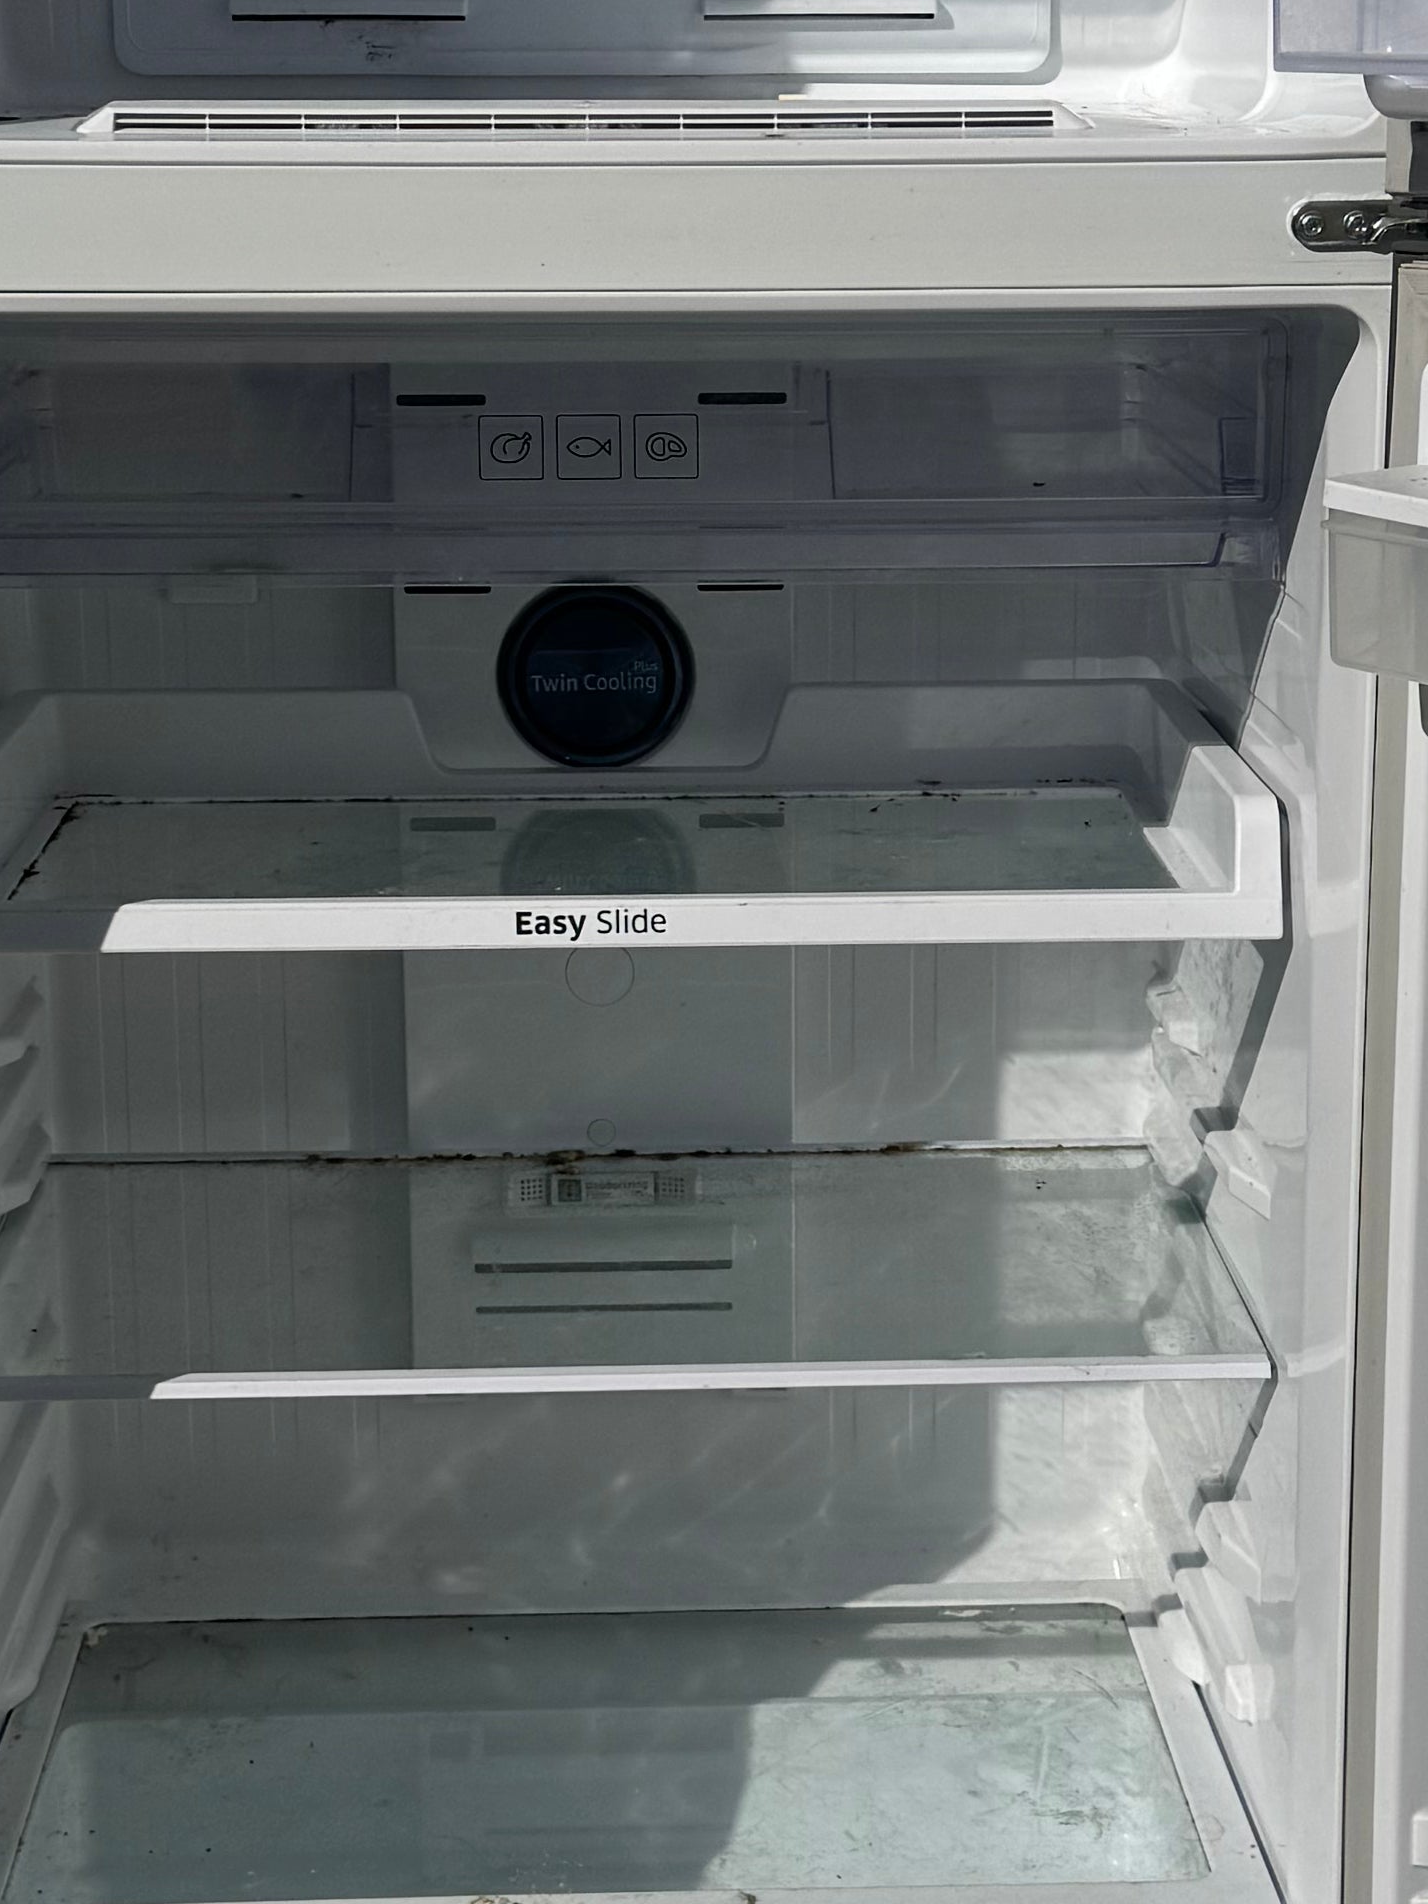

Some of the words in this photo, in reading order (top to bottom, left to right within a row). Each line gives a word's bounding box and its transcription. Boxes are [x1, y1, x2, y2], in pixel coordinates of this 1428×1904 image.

[531, 673, 578, 692] Twin
[583, 671, 657, 694] Cooling
[515, 911, 586, 941] Easy
[596, 909, 667, 934] Slide
